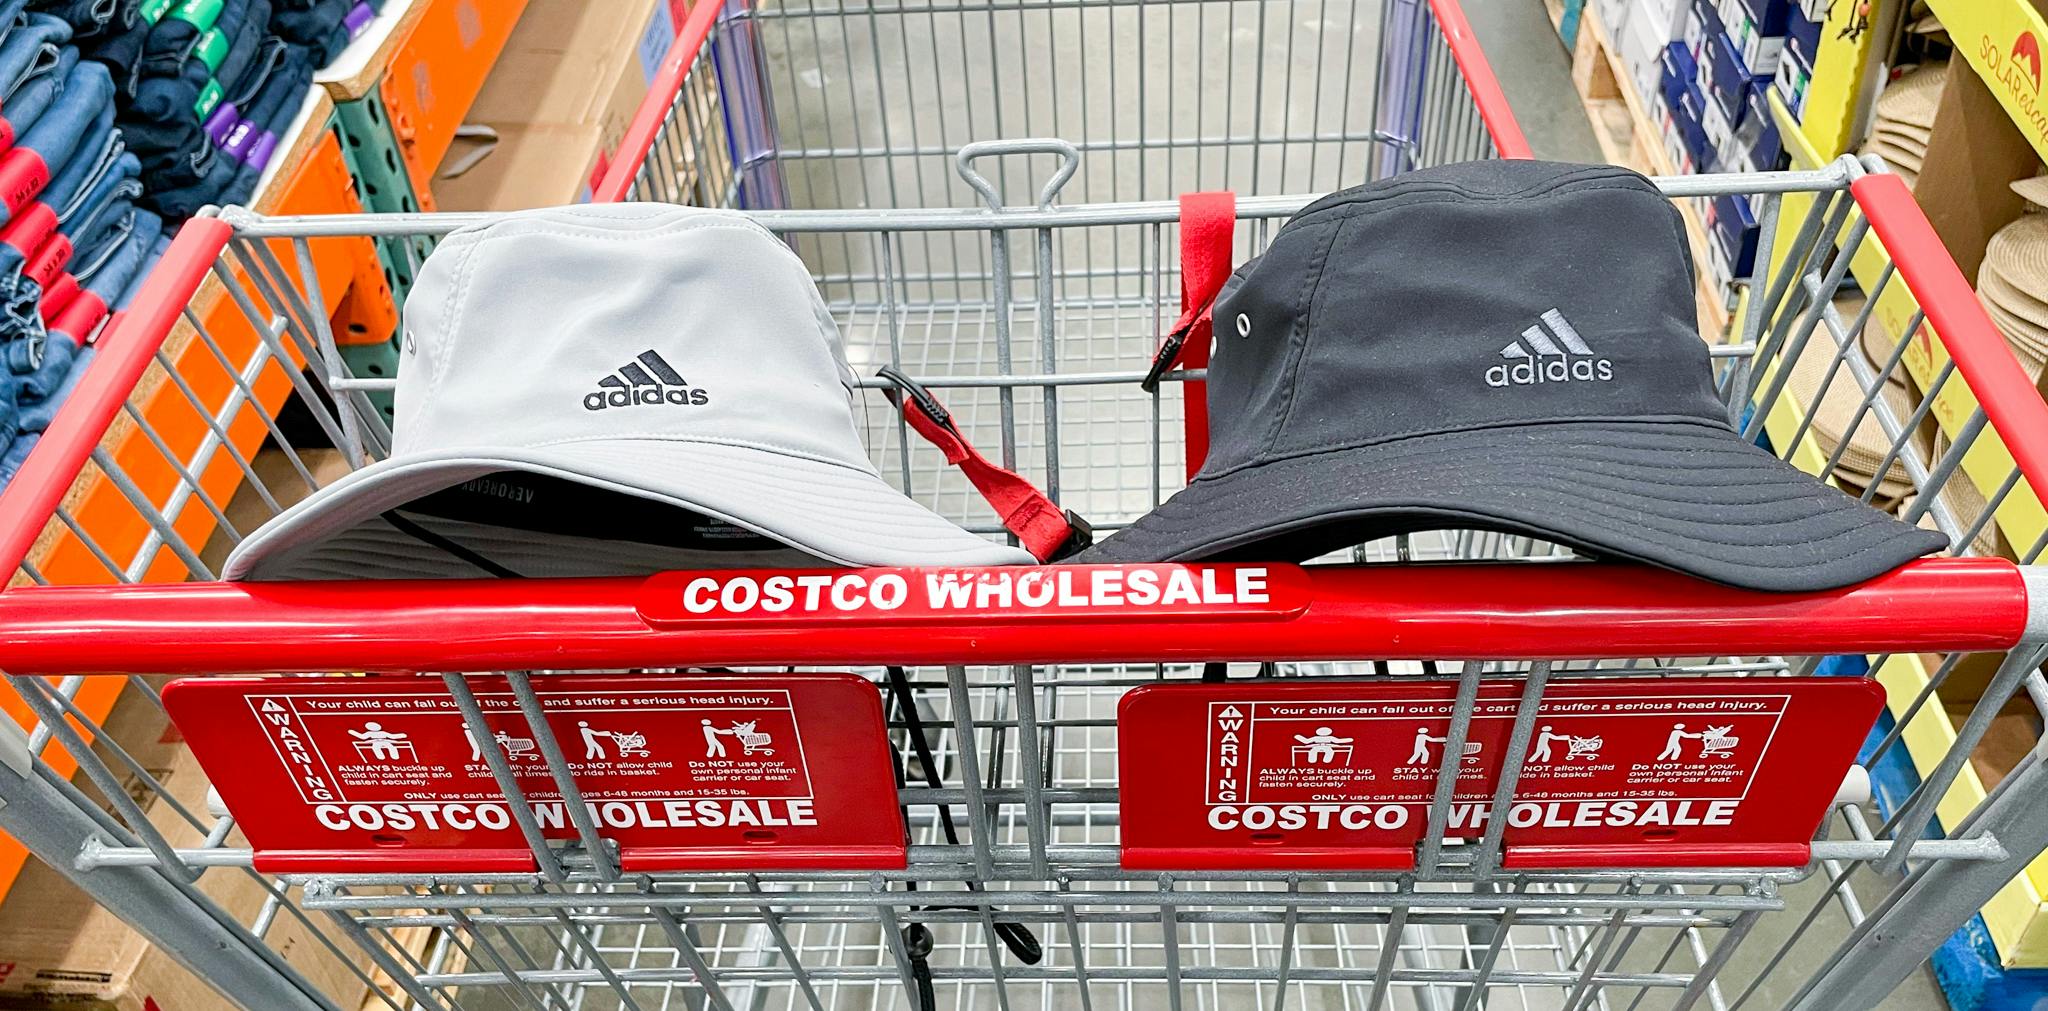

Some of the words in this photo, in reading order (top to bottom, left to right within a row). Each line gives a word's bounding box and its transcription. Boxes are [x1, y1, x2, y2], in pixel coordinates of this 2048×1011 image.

[1485, 353, 1613, 387] adidas
[583, 384, 709, 410] adidas
[683, 575, 908, 612] COSTCO
[926, 568, 1270, 609] WHOLESALE
[306, 701, 342, 709] Your
[346, 700, 381, 708] child
[414, 700, 436, 708] fall
[440, 701, 458, 709] ou
[485, 699, 508, 707] the
[544, 698, 570, 706] and
[575, 698, 616, 706] suffer
[633, 697, 686, 705] serious
[690, 696, 725, 704] head
[729, 696, 774, 706] injury.
[1270, 707, 1305, 715] Your
[1309, 706, 1346, 714] child
[1382, 706, 1404, 714] fall
[1409, 705, 1433, 713] out
[1487, 704, 1516, 712] cart
[1552, 703, 1597, 711] suffer
[1615, 702, 1672, 710] serious
[1677, 701, 1715, 709] head
[1719, 701, 1767, 711] injury.
[264, 713, 334, 800] WARNING
[1218, 719, 1244, 801] WARNING
[431, 765, 445, 773] up
[760, 761, 784, 769] your
[1708, 763, 1736, 771] your
[341, 771, 367, 779] child
[406, 771, 430, 779] seat
[716, 767, 763, 776] personal
[1656, 769, 1707, 778] personal
[381, 778, 430, 787] securely.
[1296, 781, 1346, 789] securely.
[581, 792, 601, 800] ges
[630, 789, 671, 797] months
[697, 788, 727, 796] 15-35
[1658, 789, 1678, 797] lbs.
[315, 803, 511, 831] COSTCO
[1207, 805, 1409, 830] COSTCO
